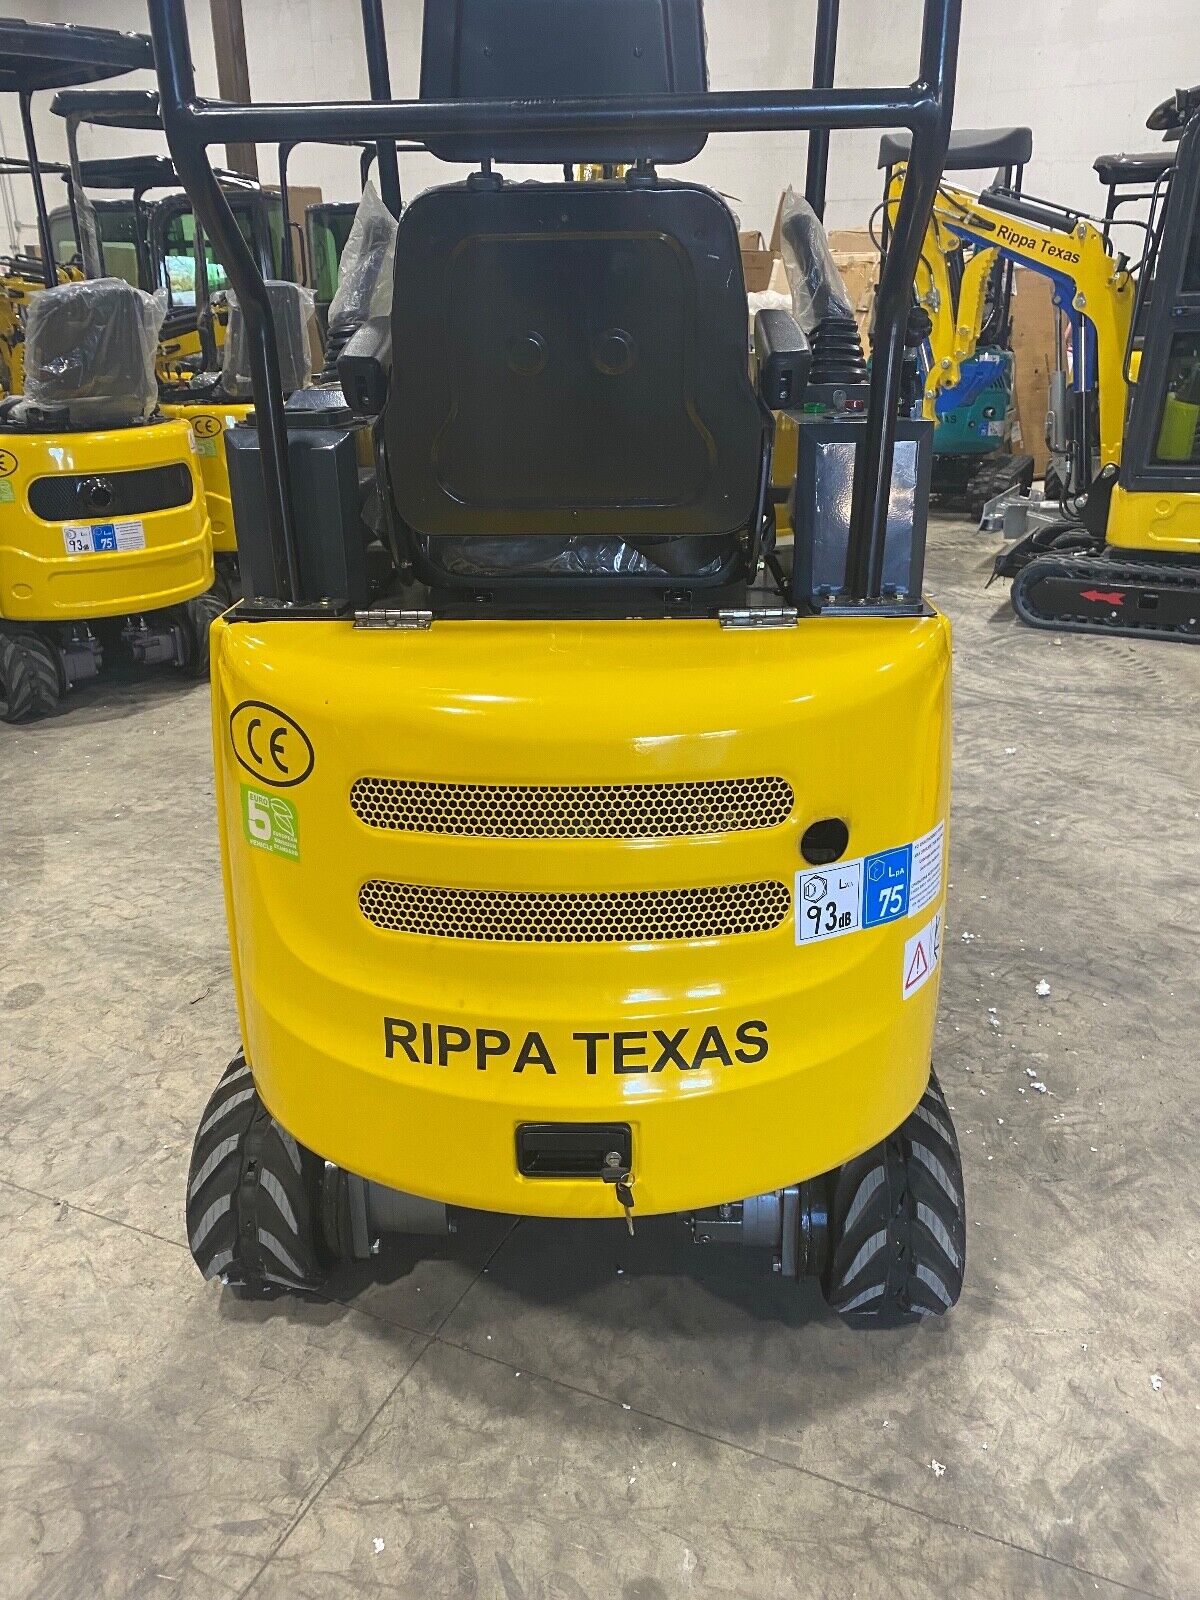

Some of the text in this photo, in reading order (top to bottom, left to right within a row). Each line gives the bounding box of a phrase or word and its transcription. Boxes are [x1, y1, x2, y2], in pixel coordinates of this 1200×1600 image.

[996, 224, 1081, 264] Rippa Texas
[100, 537, 113, 549] 75
[247, 718, 289, 774] CE
[249, 792, 268, 806] EURO
[878, 883, 904, 918] 75
[383, 1016, 769, 1075] RIPPA TEXAS
